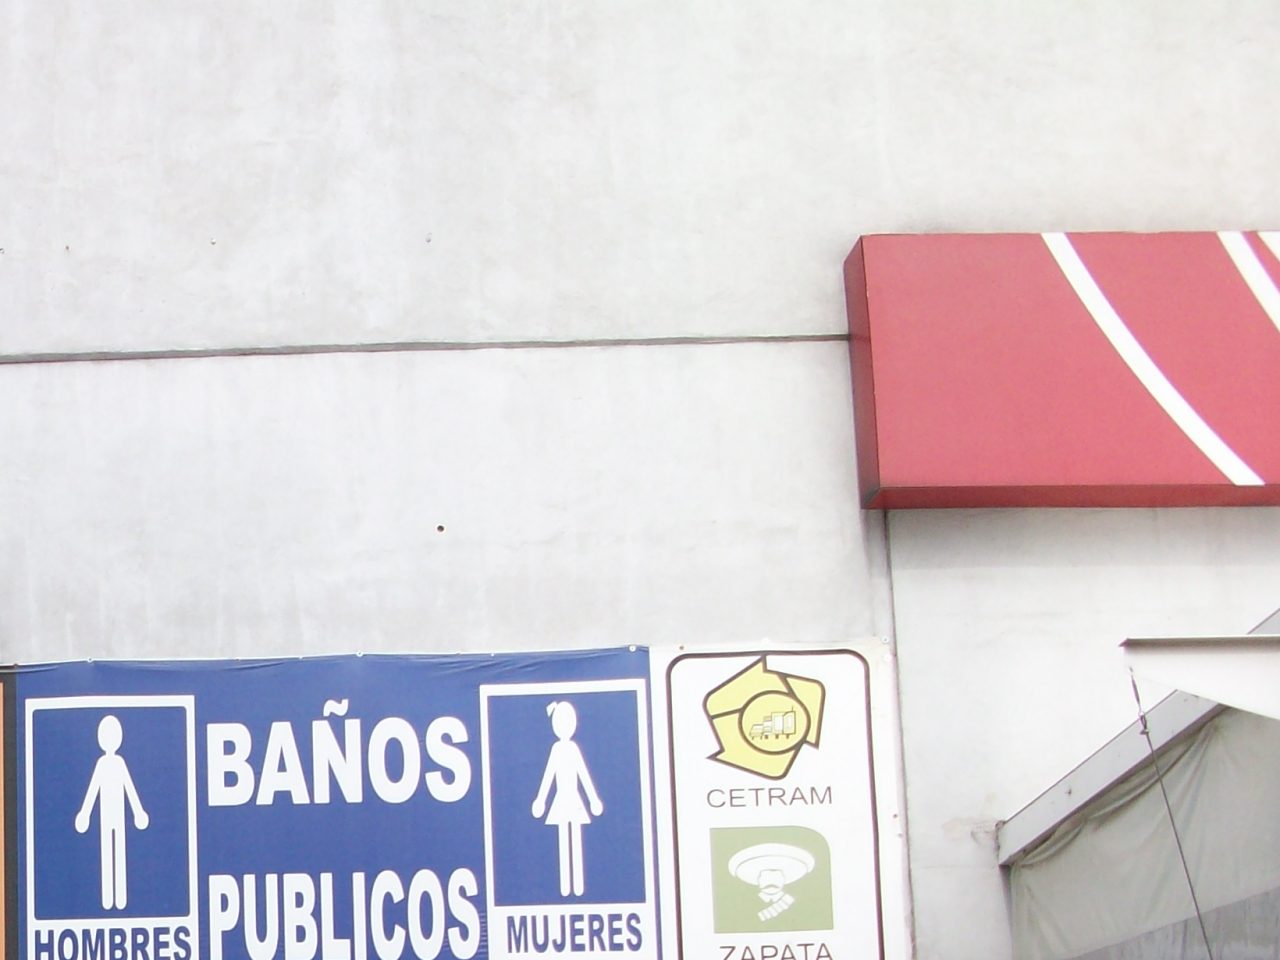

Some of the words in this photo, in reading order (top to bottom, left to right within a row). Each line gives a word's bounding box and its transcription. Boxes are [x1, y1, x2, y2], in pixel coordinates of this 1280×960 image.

[206, 698, 472, 807] BAÑOS
[706, 786, 833, 808] CETRAM
[505, 912, 644, 955] MUJERES
